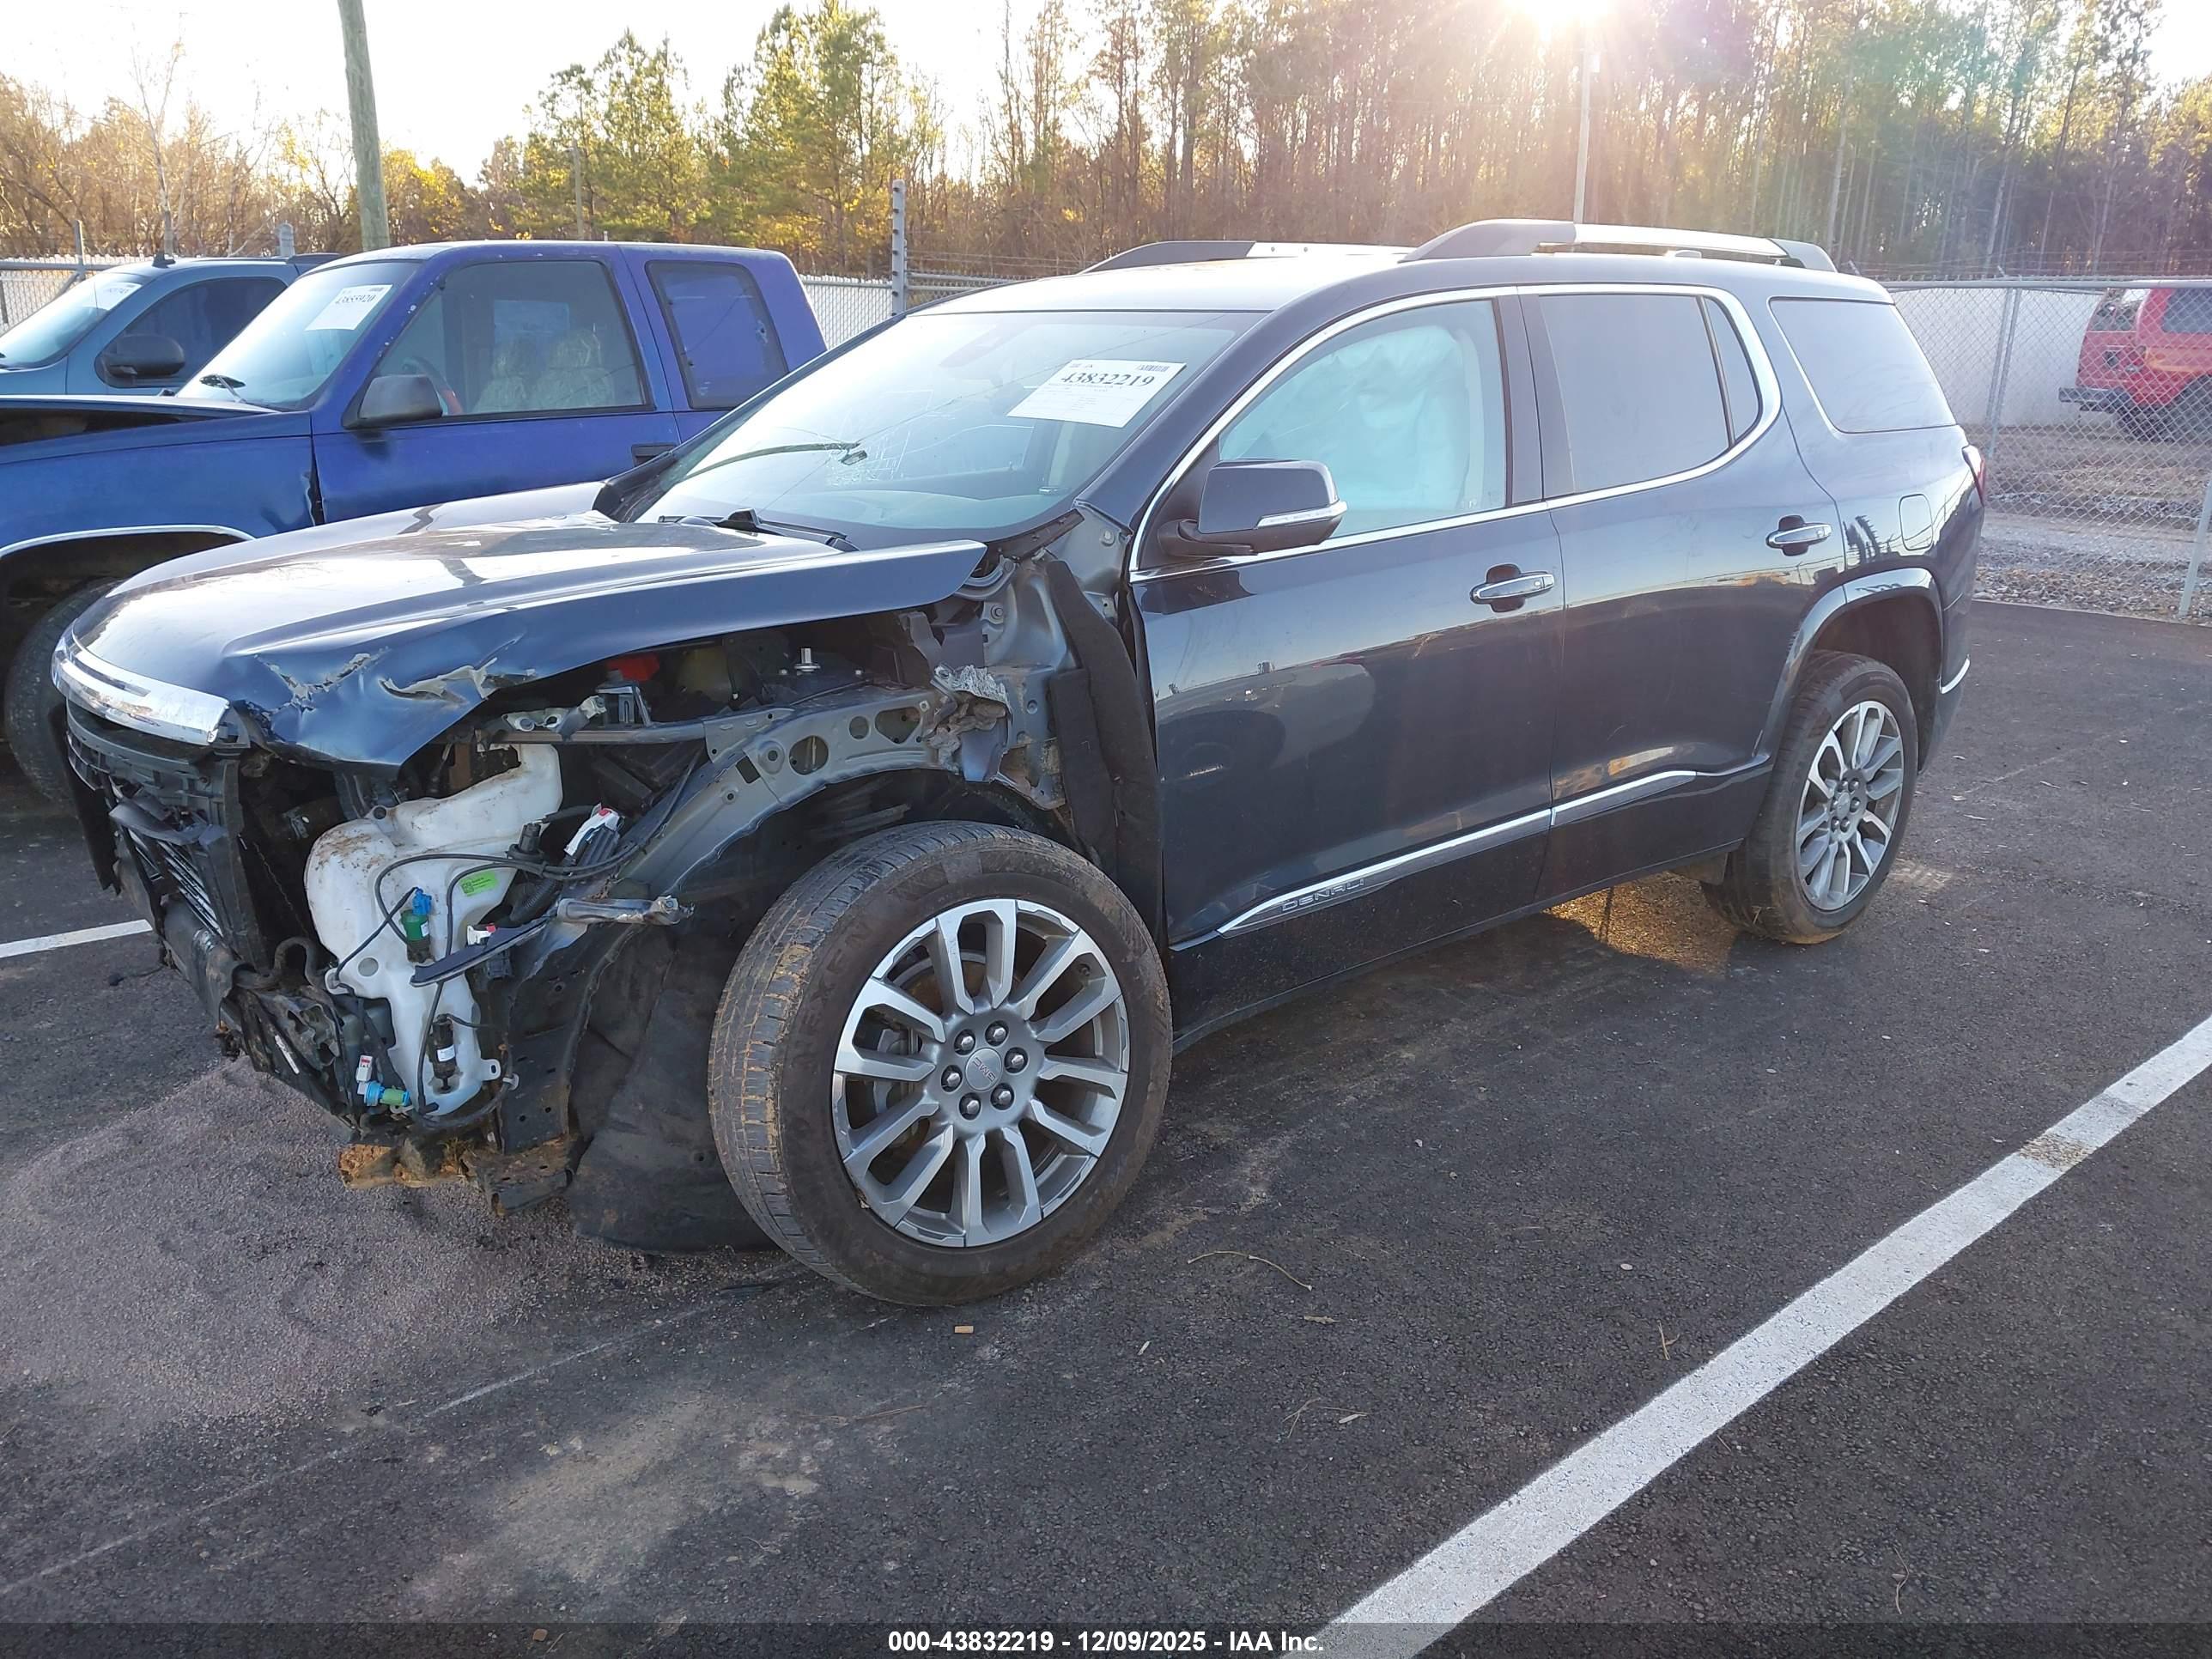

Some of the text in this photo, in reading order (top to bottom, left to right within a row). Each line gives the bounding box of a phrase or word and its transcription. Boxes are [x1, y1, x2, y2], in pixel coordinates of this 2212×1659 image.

[1060, 372, 1155, 386] 43832219
[1279, 878, 1364, 911] DENALI
[973, 1056, 996, 1083] GMC
